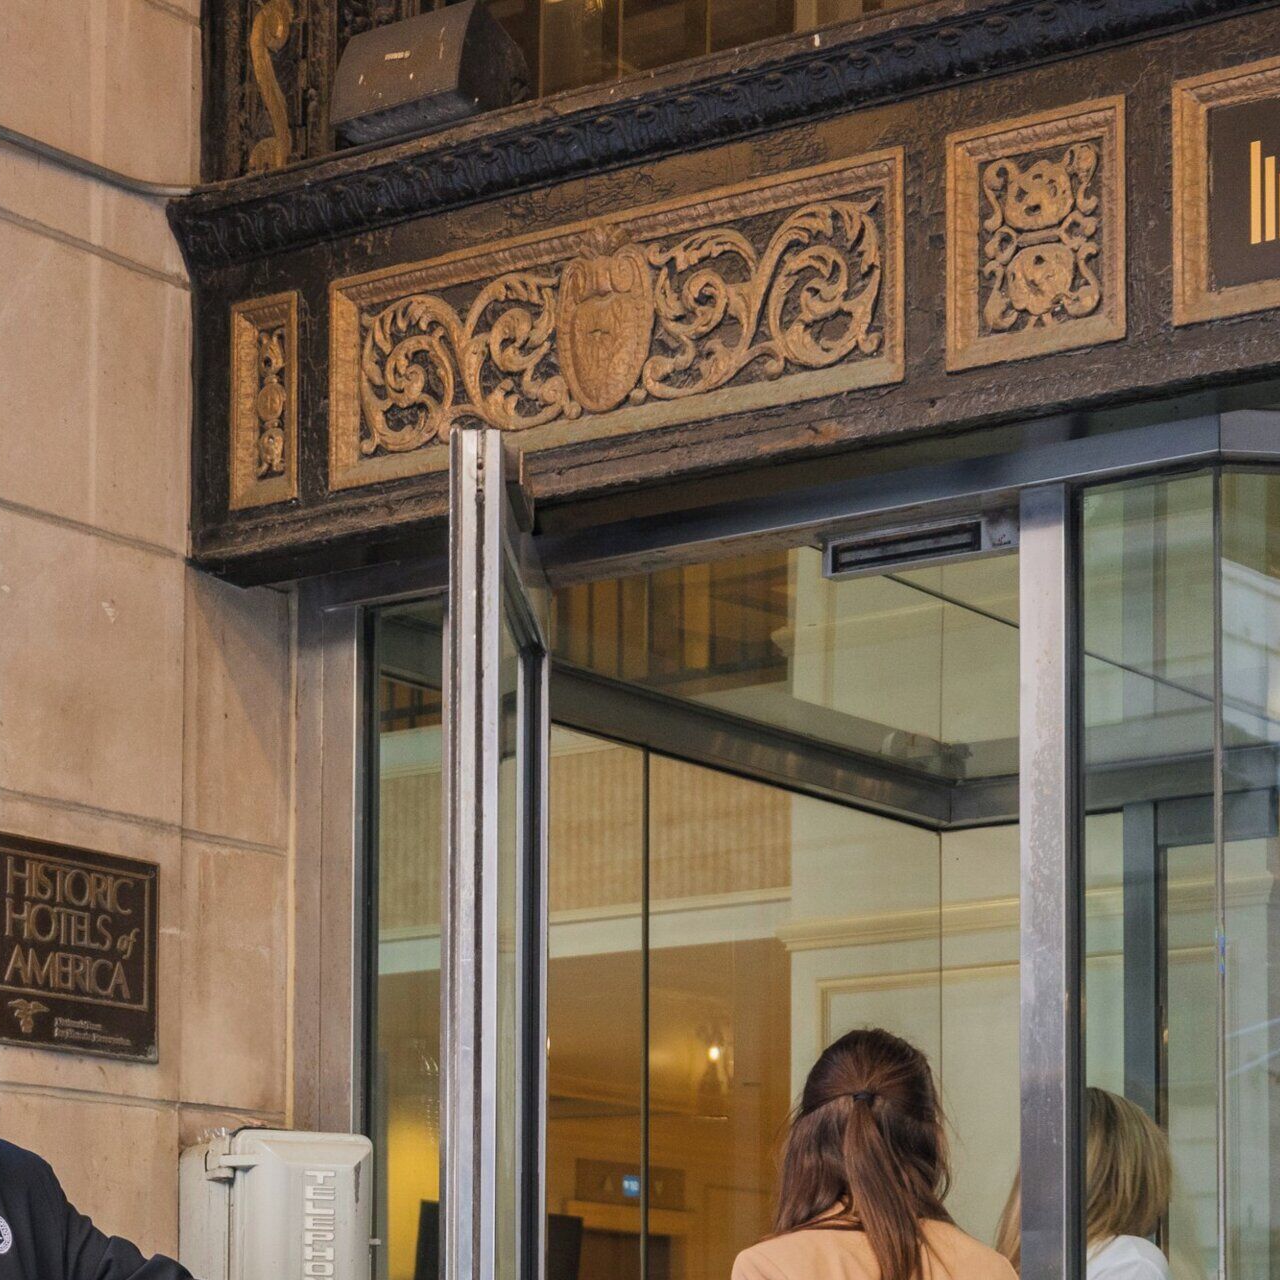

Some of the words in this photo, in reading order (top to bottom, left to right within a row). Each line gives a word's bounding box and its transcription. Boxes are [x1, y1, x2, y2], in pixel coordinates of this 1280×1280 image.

[6, 856, 134, 915] HISTORIC
[4, 897, 112, 950] HOTELS
[116, 927, 141, 960] of
[4, 944, 131, 1000] AMERICA
